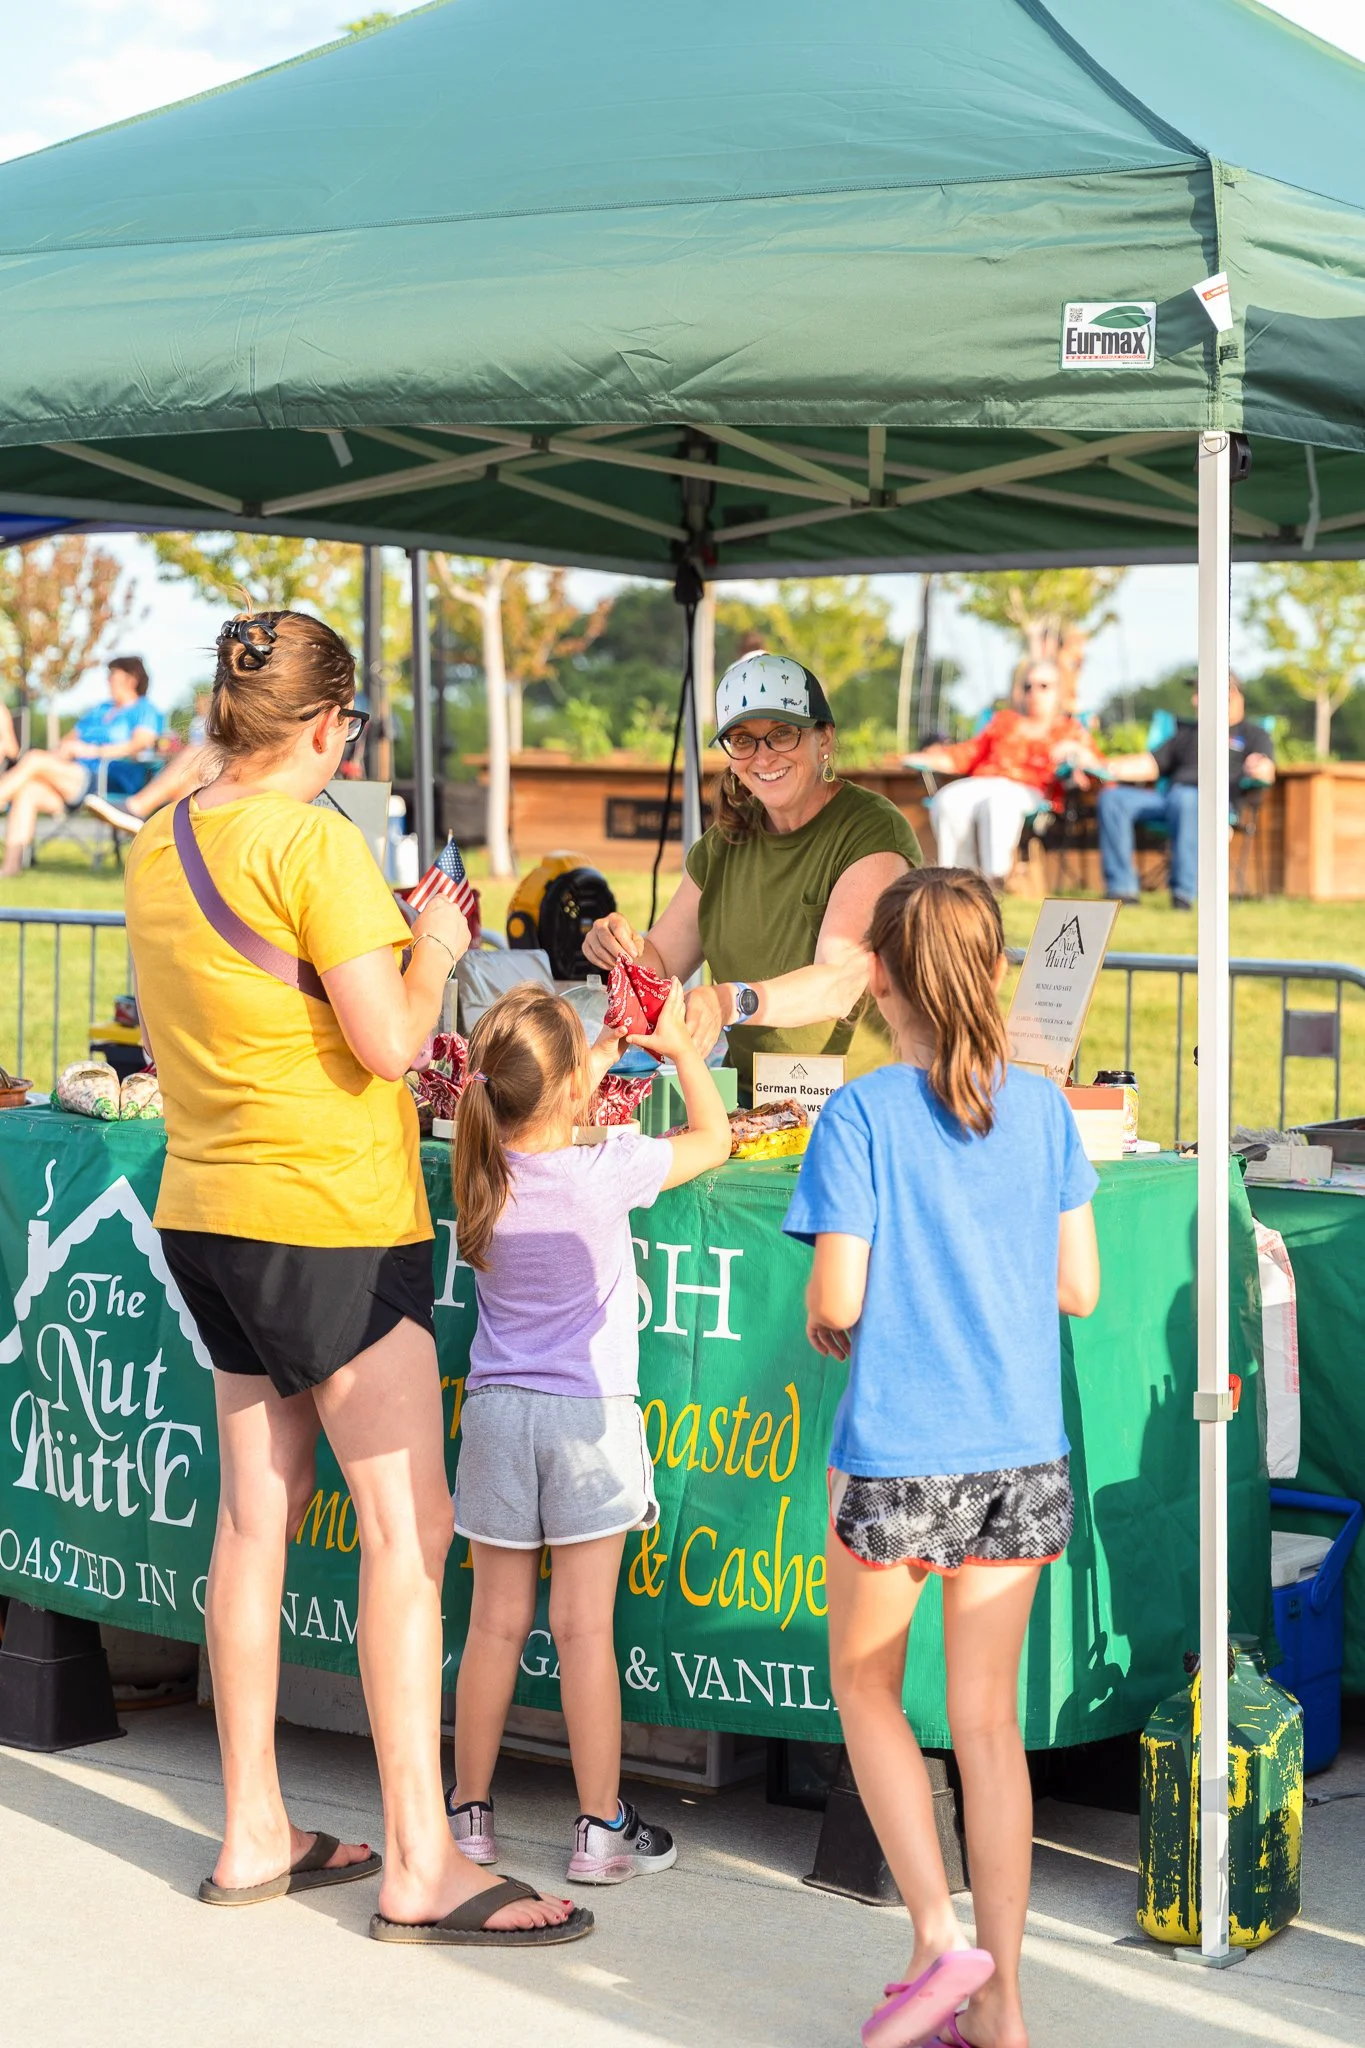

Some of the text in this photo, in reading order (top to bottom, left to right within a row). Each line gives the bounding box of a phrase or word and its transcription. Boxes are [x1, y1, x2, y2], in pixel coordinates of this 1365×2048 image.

[1066, 328, 1146, 355] Eurmax
[1058, 937, 1077, 956] Nut
[755, 1083, 838, 1096] German Roaste
[67, 1272, 146, 1323] The
[37, 1324, 167, 1442] Nut
[644, 1382, 800, 1482] oasted
[628, 1496, 829, 1631] & Cashe
[0, 1528, 126, 1600] OASTED
[135, 1562, 177, 1611] IN
[625, 1646, 660, 1692] &
[671, 1652, 840, 1711] VANIL
